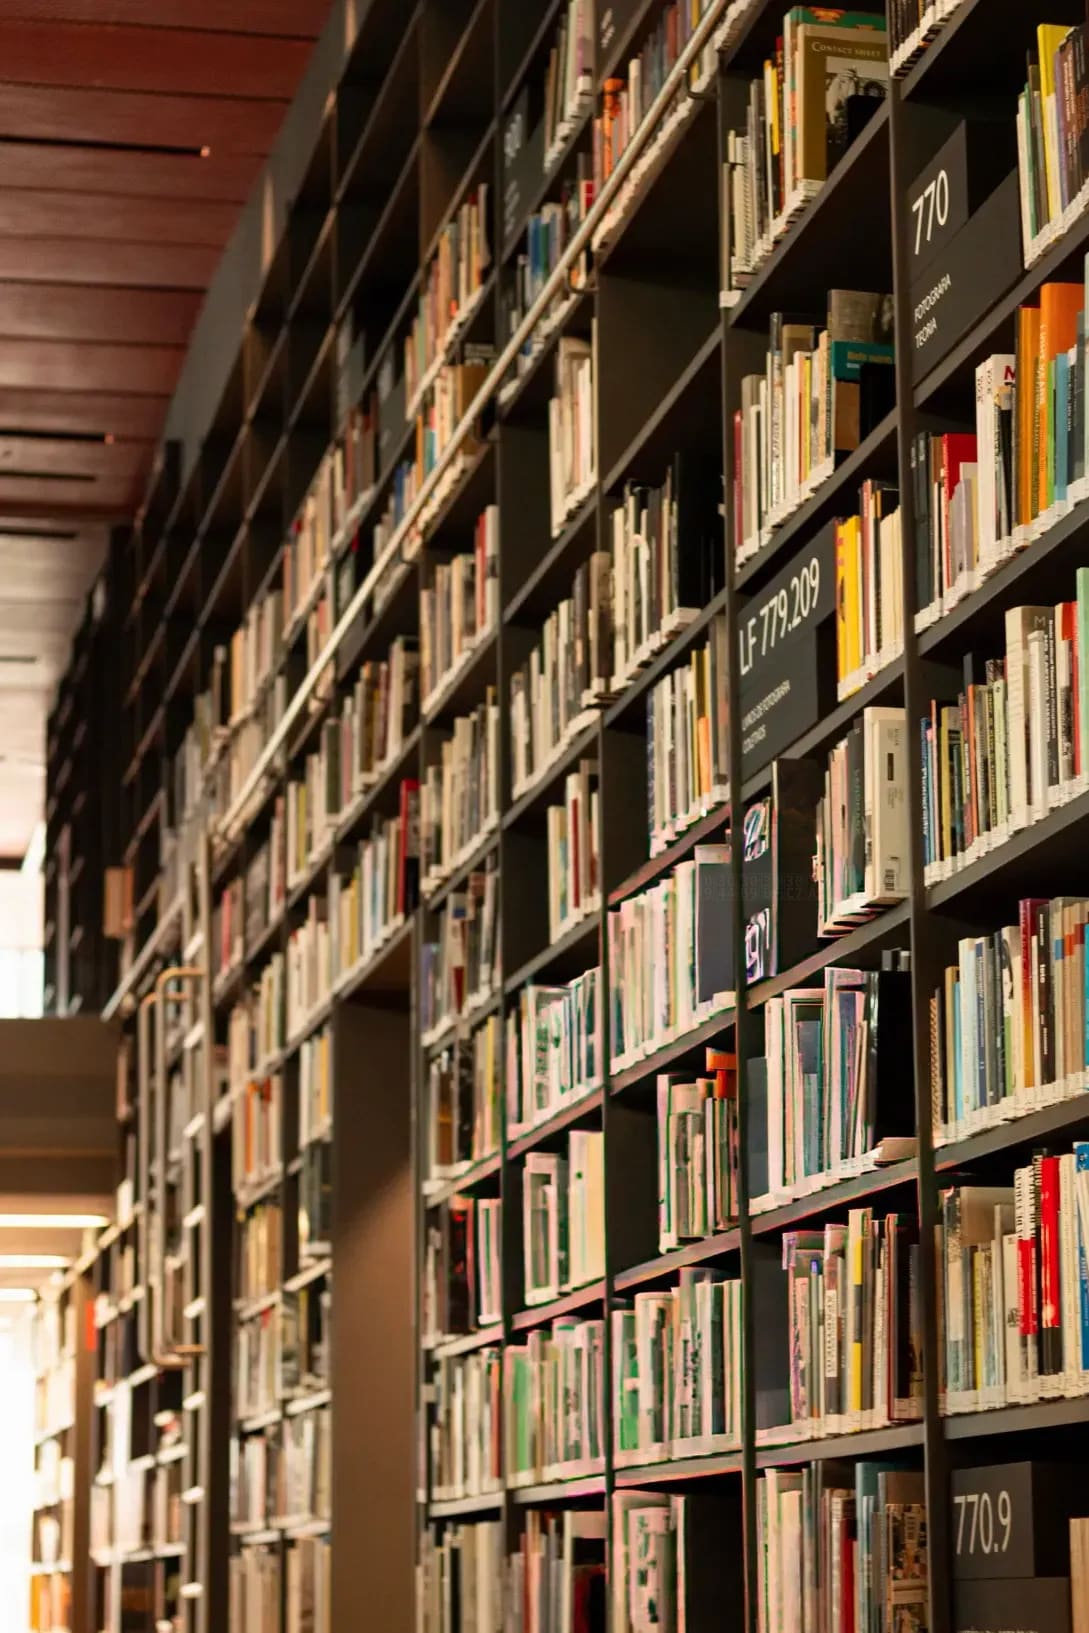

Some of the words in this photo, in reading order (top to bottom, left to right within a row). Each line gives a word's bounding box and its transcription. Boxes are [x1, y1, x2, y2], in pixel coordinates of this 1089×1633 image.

[912, 169, 950, 256] 770
[913, 272, 952, 324] FOTOGRAFIA
[914, 317, 938, 349] TEORIA
[738, 617, 758, 677] LF
[759, 556, 821, 657] 779.209
[953, 1490, 1012, 1556] 770.9
